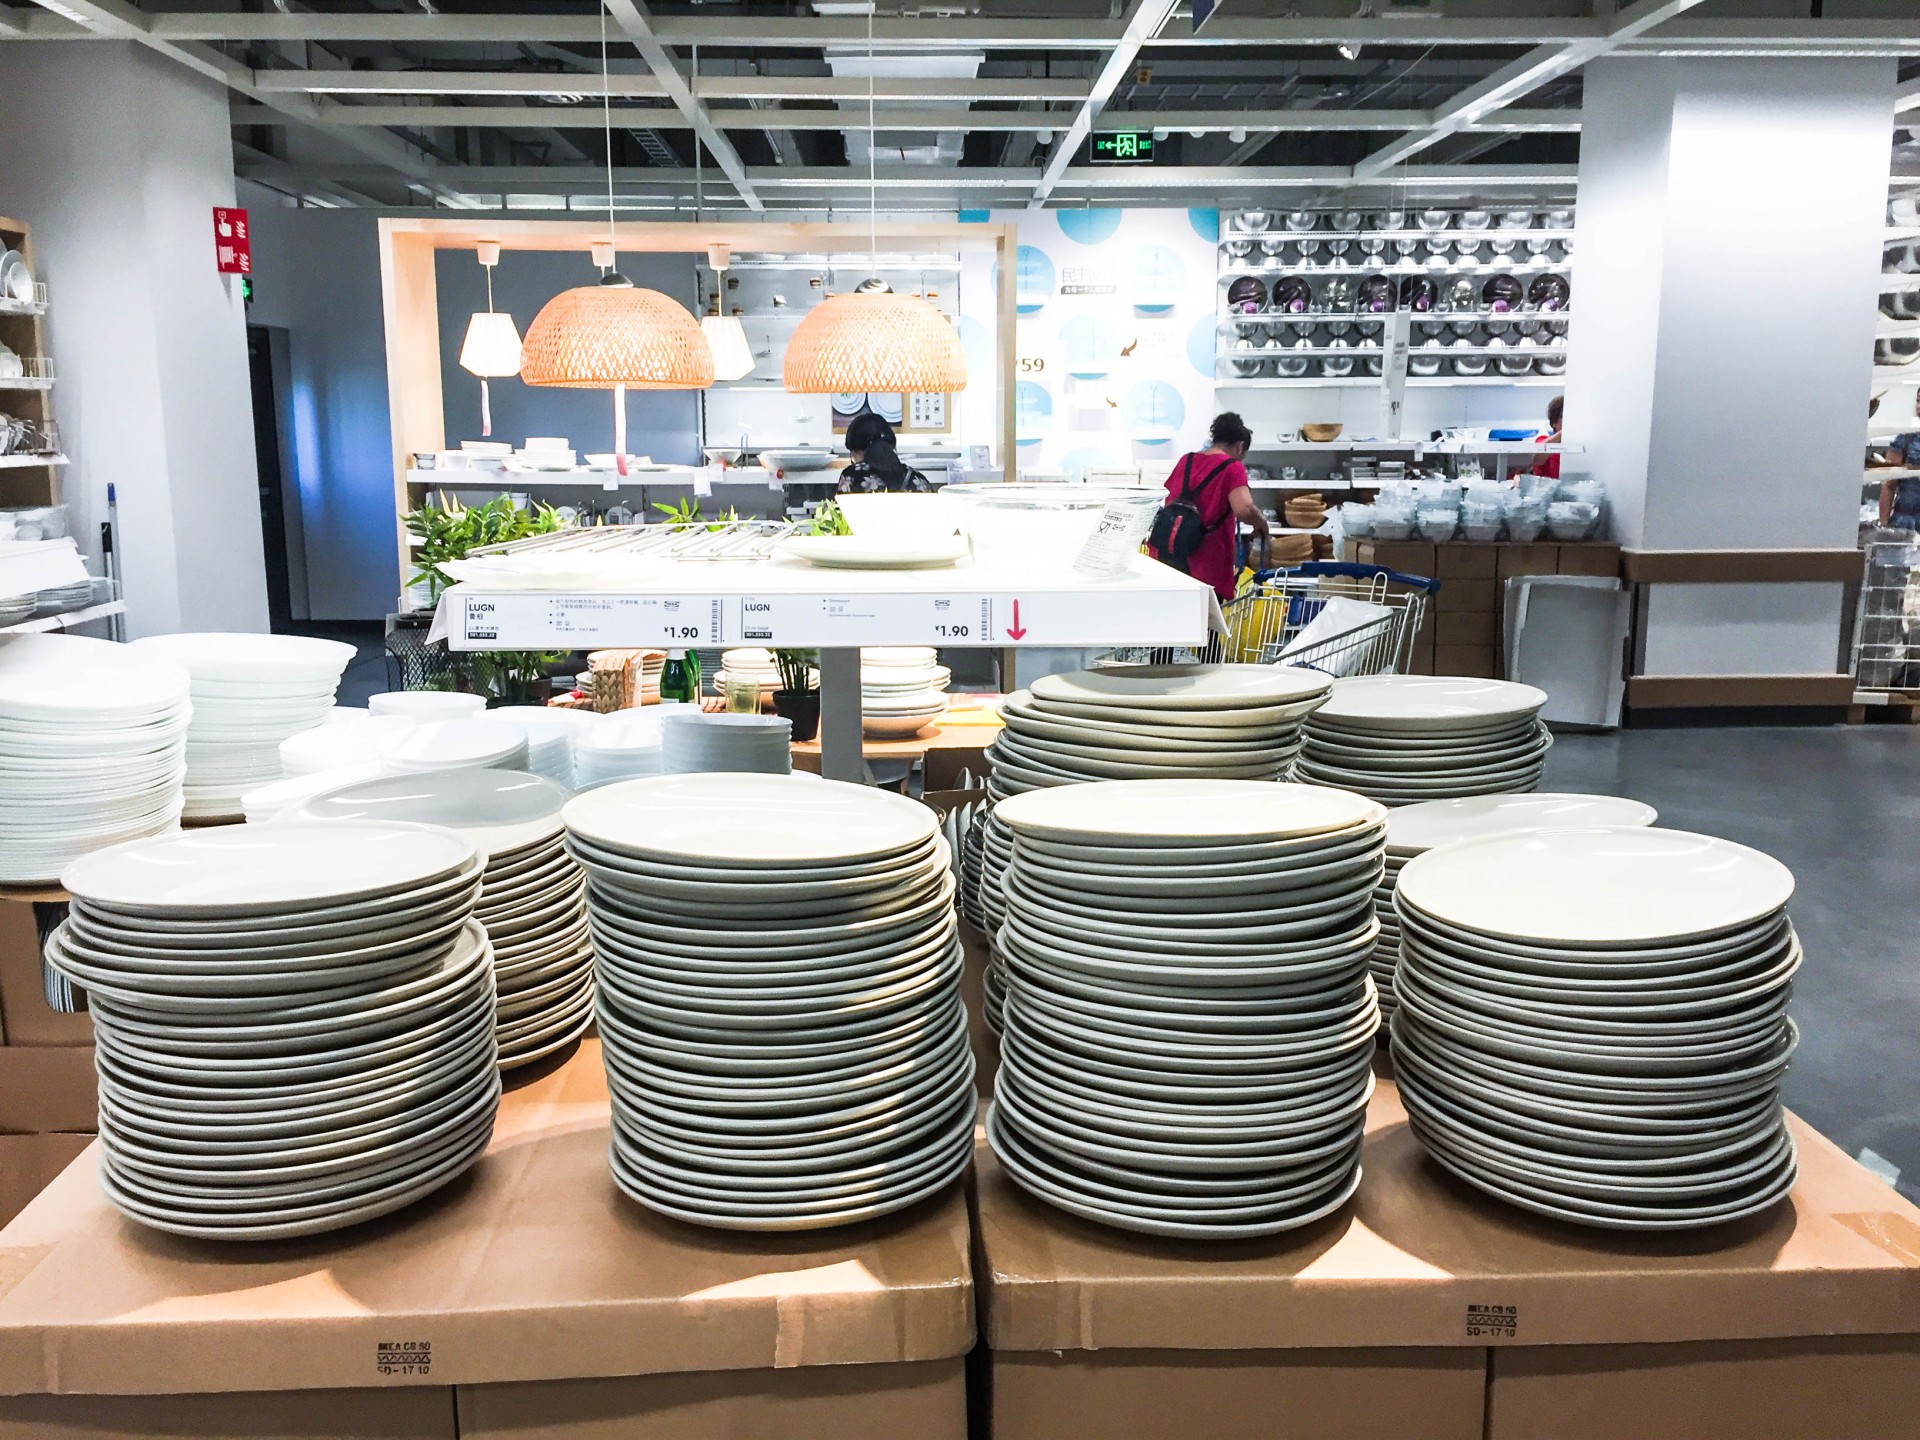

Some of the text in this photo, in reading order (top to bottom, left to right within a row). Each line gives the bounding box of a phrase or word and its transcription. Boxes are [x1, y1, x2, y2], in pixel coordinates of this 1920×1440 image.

[1015, 357, 1045, 373] 59
[468, 603, 495, 612] LUGN
[745, 603, 770, 612] LUGN
[663, 626, 699, 639] ¥1.90
[934, 624, 969, 637] ¥1.90
